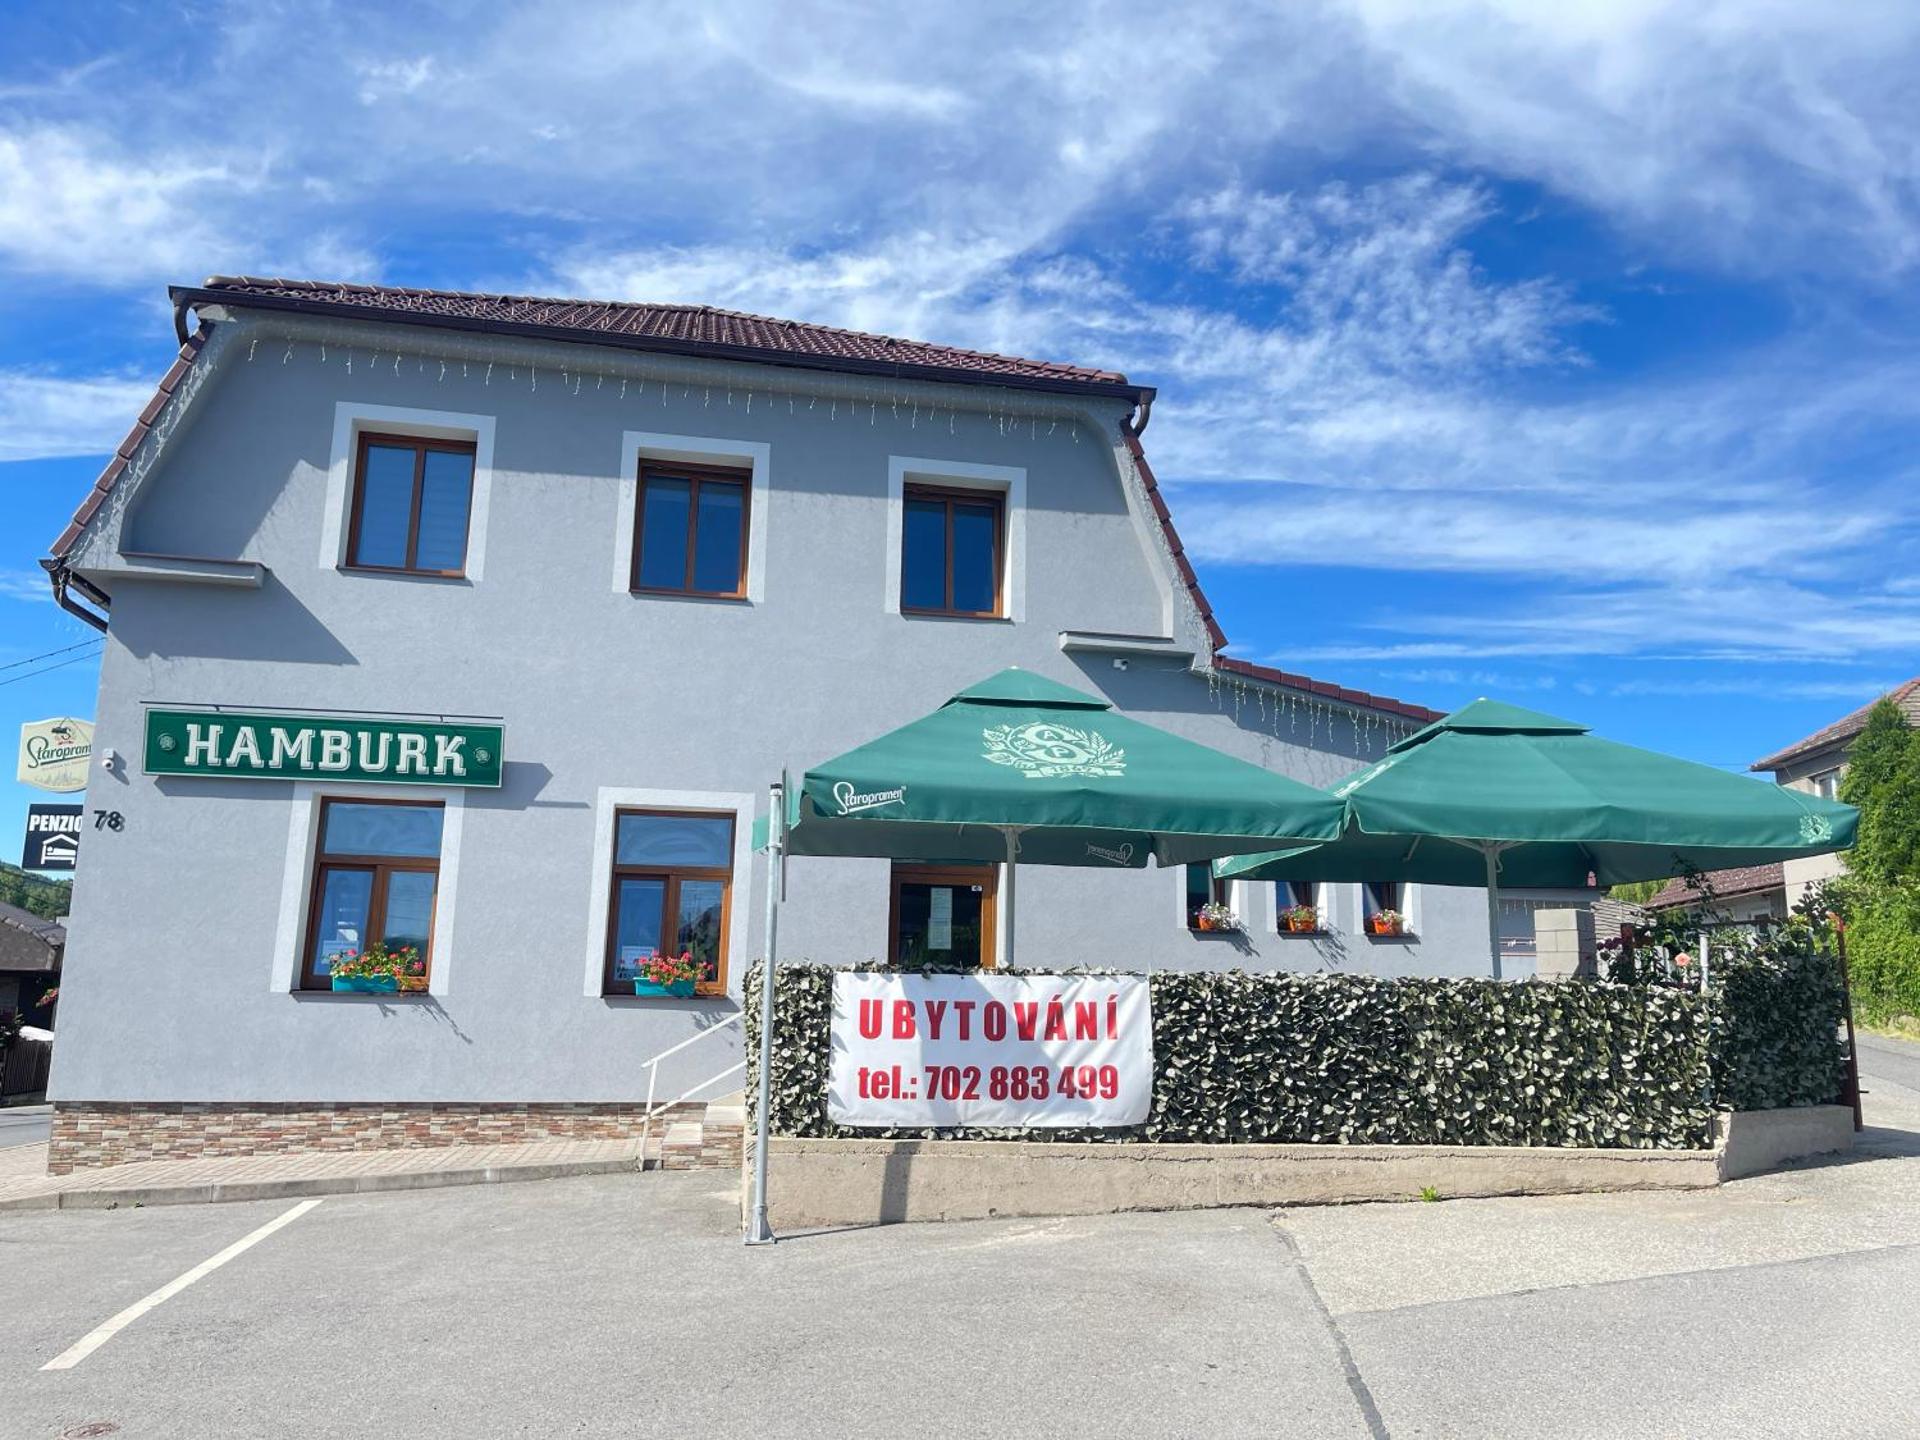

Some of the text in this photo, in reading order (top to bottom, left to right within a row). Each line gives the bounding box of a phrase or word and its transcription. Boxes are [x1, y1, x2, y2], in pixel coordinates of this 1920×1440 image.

[184, 723, 467, 777] HAMBURK
[833, 782, 903, 815] Staropramen
[94, 810, 121, 829] 78
[859, 994, 1119, 1041] UBYTOVÁNÍ
[858, 1065, 1119, 1099] tel.: 702 883 499
